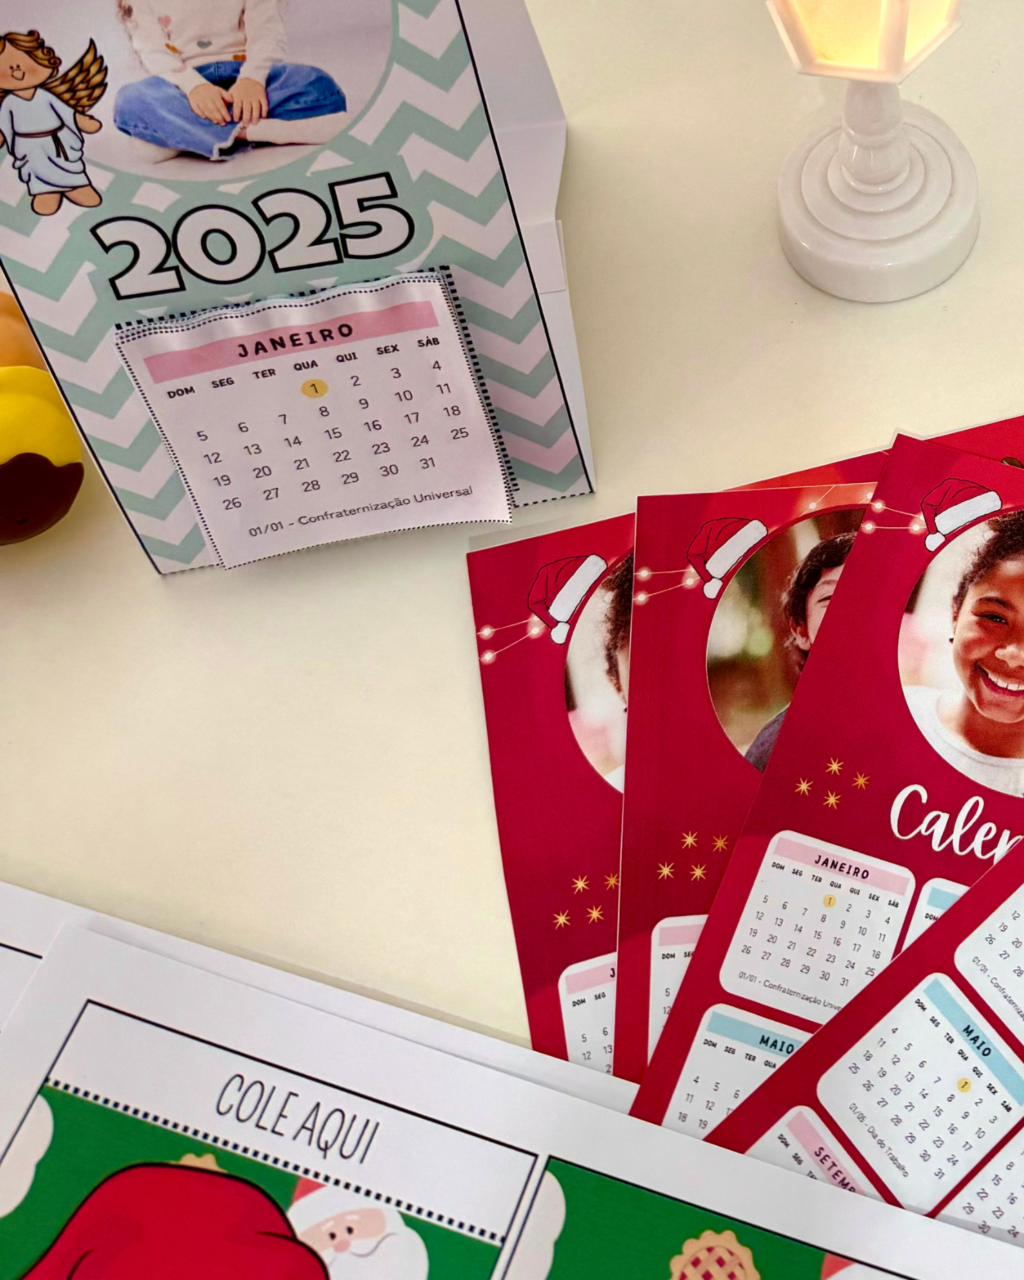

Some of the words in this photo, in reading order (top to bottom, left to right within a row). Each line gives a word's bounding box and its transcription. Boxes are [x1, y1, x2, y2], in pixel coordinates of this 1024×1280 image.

[90, 172, 416, 300] 2025
[238, 323, 354, 358] JANEIRO
[166, 386, 196, 399] DOM
[210, 377, 235, 388] SEG
[252, 368, 276, 379] TER
[293, 360, 318, 371] QUA
[336, 352, 358, 363] QUI
[376, 344, 400, 356] SEX
[417, 336, 440, 348] SÁB
[311, 384, 318, 394] 1
[350, 375, 362, 386] 2
[390, 368, 402, 379] 3
[432, 360, 442, 370] 4
[196, 430, 208, 442] 5
[238, 422, 249, 433] 6
[278, 414, 286, 425] 7
[318, 406, 330, 417] 8
[358, 398, 369, 410] 9
[394, 390, 413, 402] 10
[436, 383, 451, 394] 11
[203, 452, 222, 464] 12
[243, 444, 262, 455] 13
[284, 436, 303, 448] 14
[324, 427, 342, 440] 15
[363, 420, 382, 432] 16
[404, 412, 419, 424] 17
[443, 405, 461, 417] 18
[249, 522, 284, 538] 01/01
[298, 494, 411, 526] Confraternização
[413, 485, 473, 505] Universal
[814, 855, 870, 880] JANEIRO
[759, 1034, 794, 1055] MAIO
[962, 1024, 992, 1058] MAIO
[215, 1073, 299, 1137] COLE
[292, 1102, 380, 1165] AQUI
